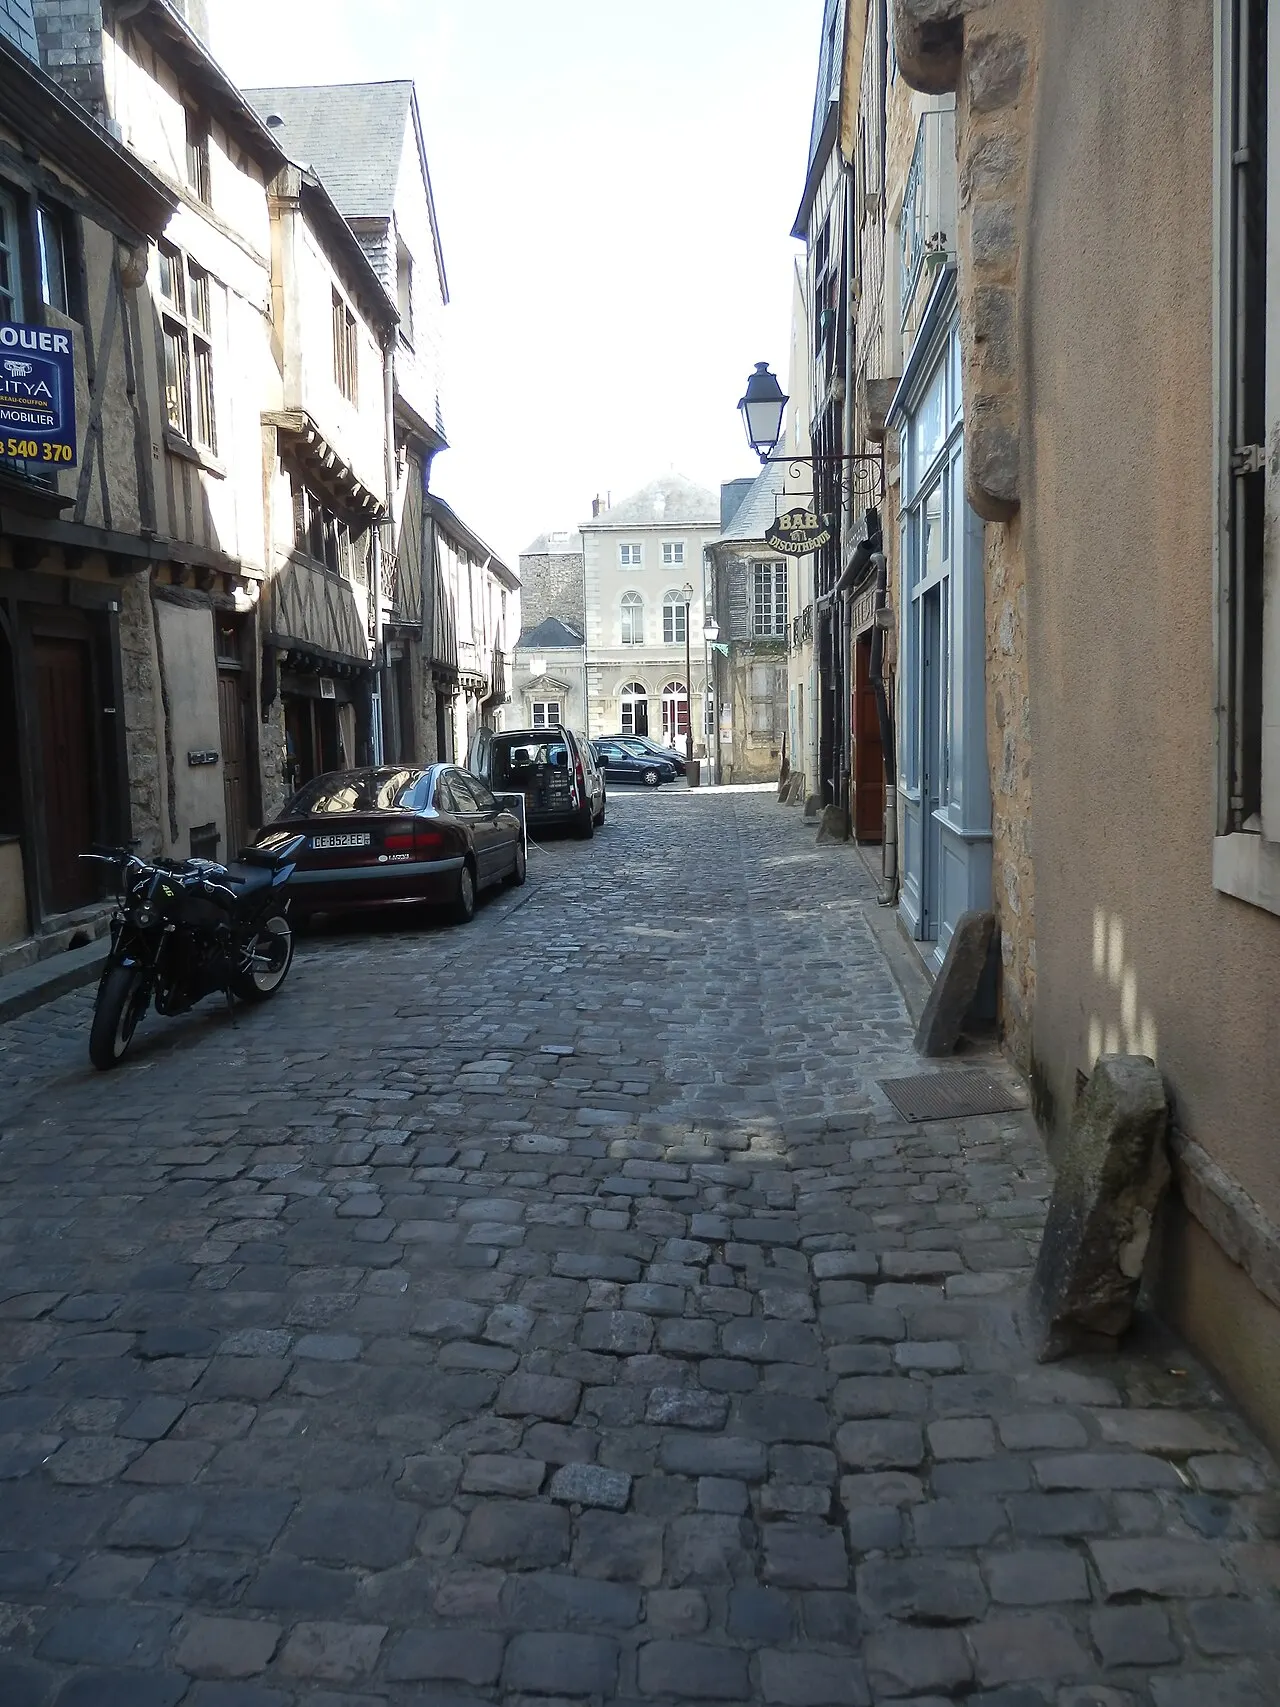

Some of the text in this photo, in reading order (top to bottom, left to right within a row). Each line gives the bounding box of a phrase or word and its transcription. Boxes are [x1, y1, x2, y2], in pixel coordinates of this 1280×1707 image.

[0, 326, 70, 354] OUER
[0, 409, 54, 426] MOBILIER
[7, 438, 38, 458] 540
[42, 442, 73, 462] 370
[778, 513, 819, 531] BAR
